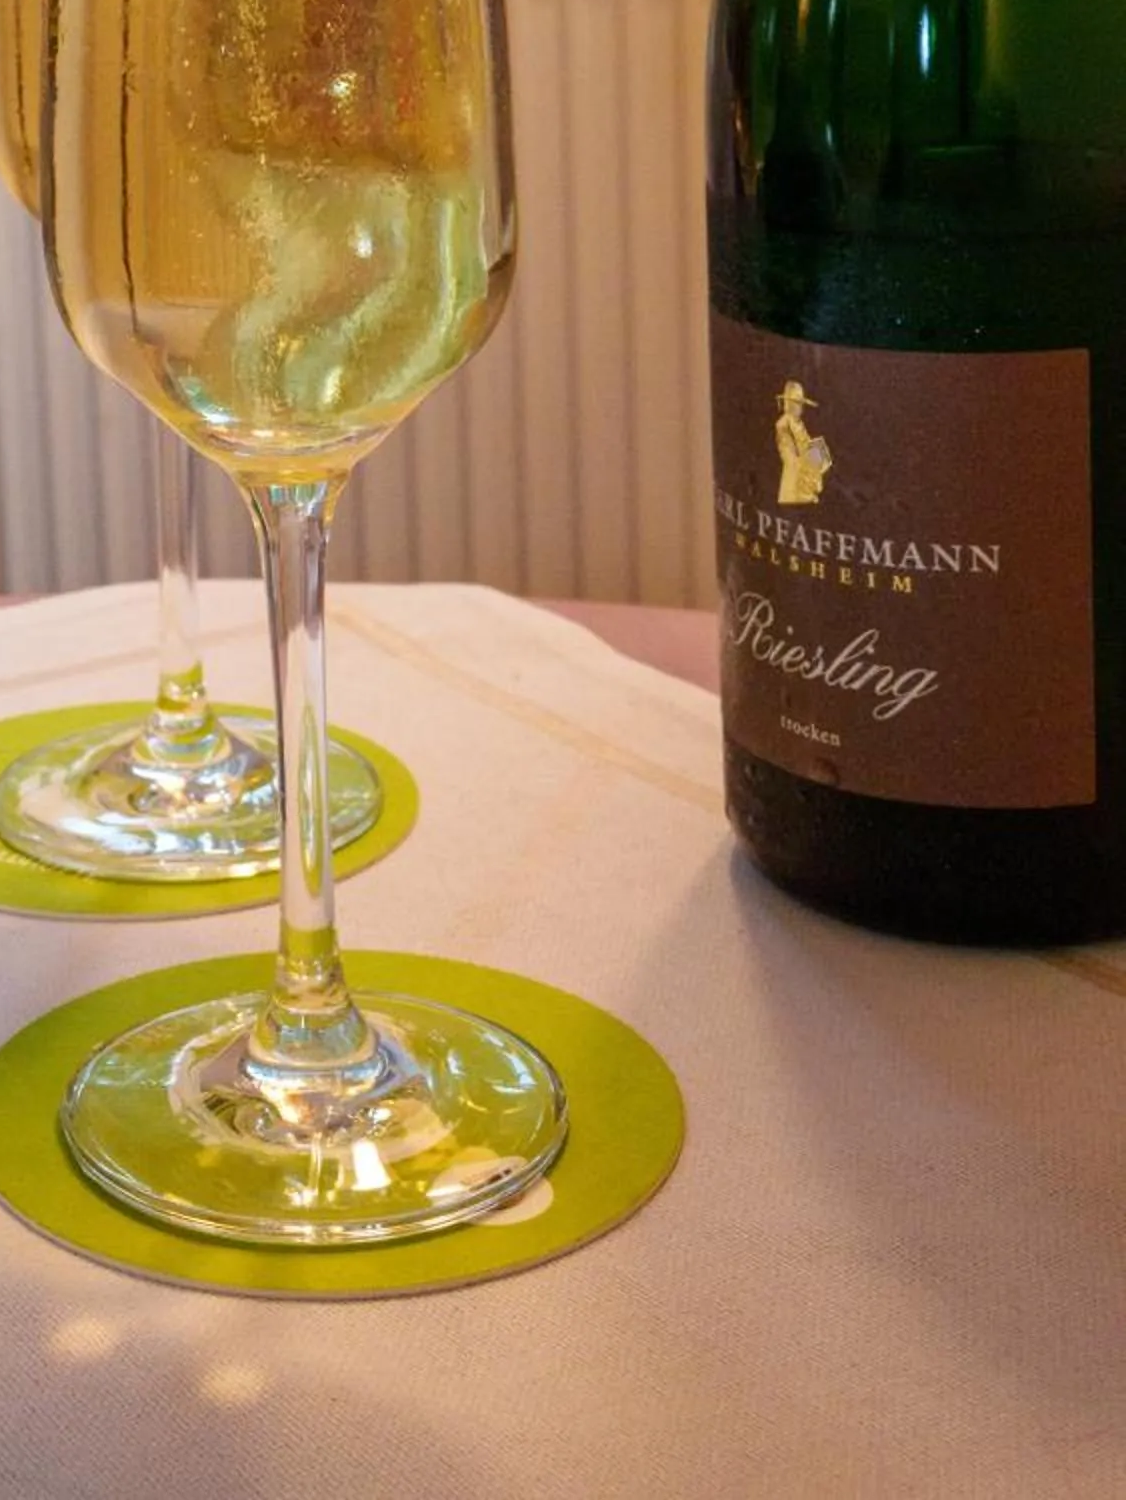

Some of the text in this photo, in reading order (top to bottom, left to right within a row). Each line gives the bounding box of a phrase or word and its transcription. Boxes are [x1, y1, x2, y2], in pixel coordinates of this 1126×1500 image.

[757, 510, 1001, 573] PFAFFMANN
[732, 591, 939, 721] Riesling
[780, 715, 841, 747] trocken
